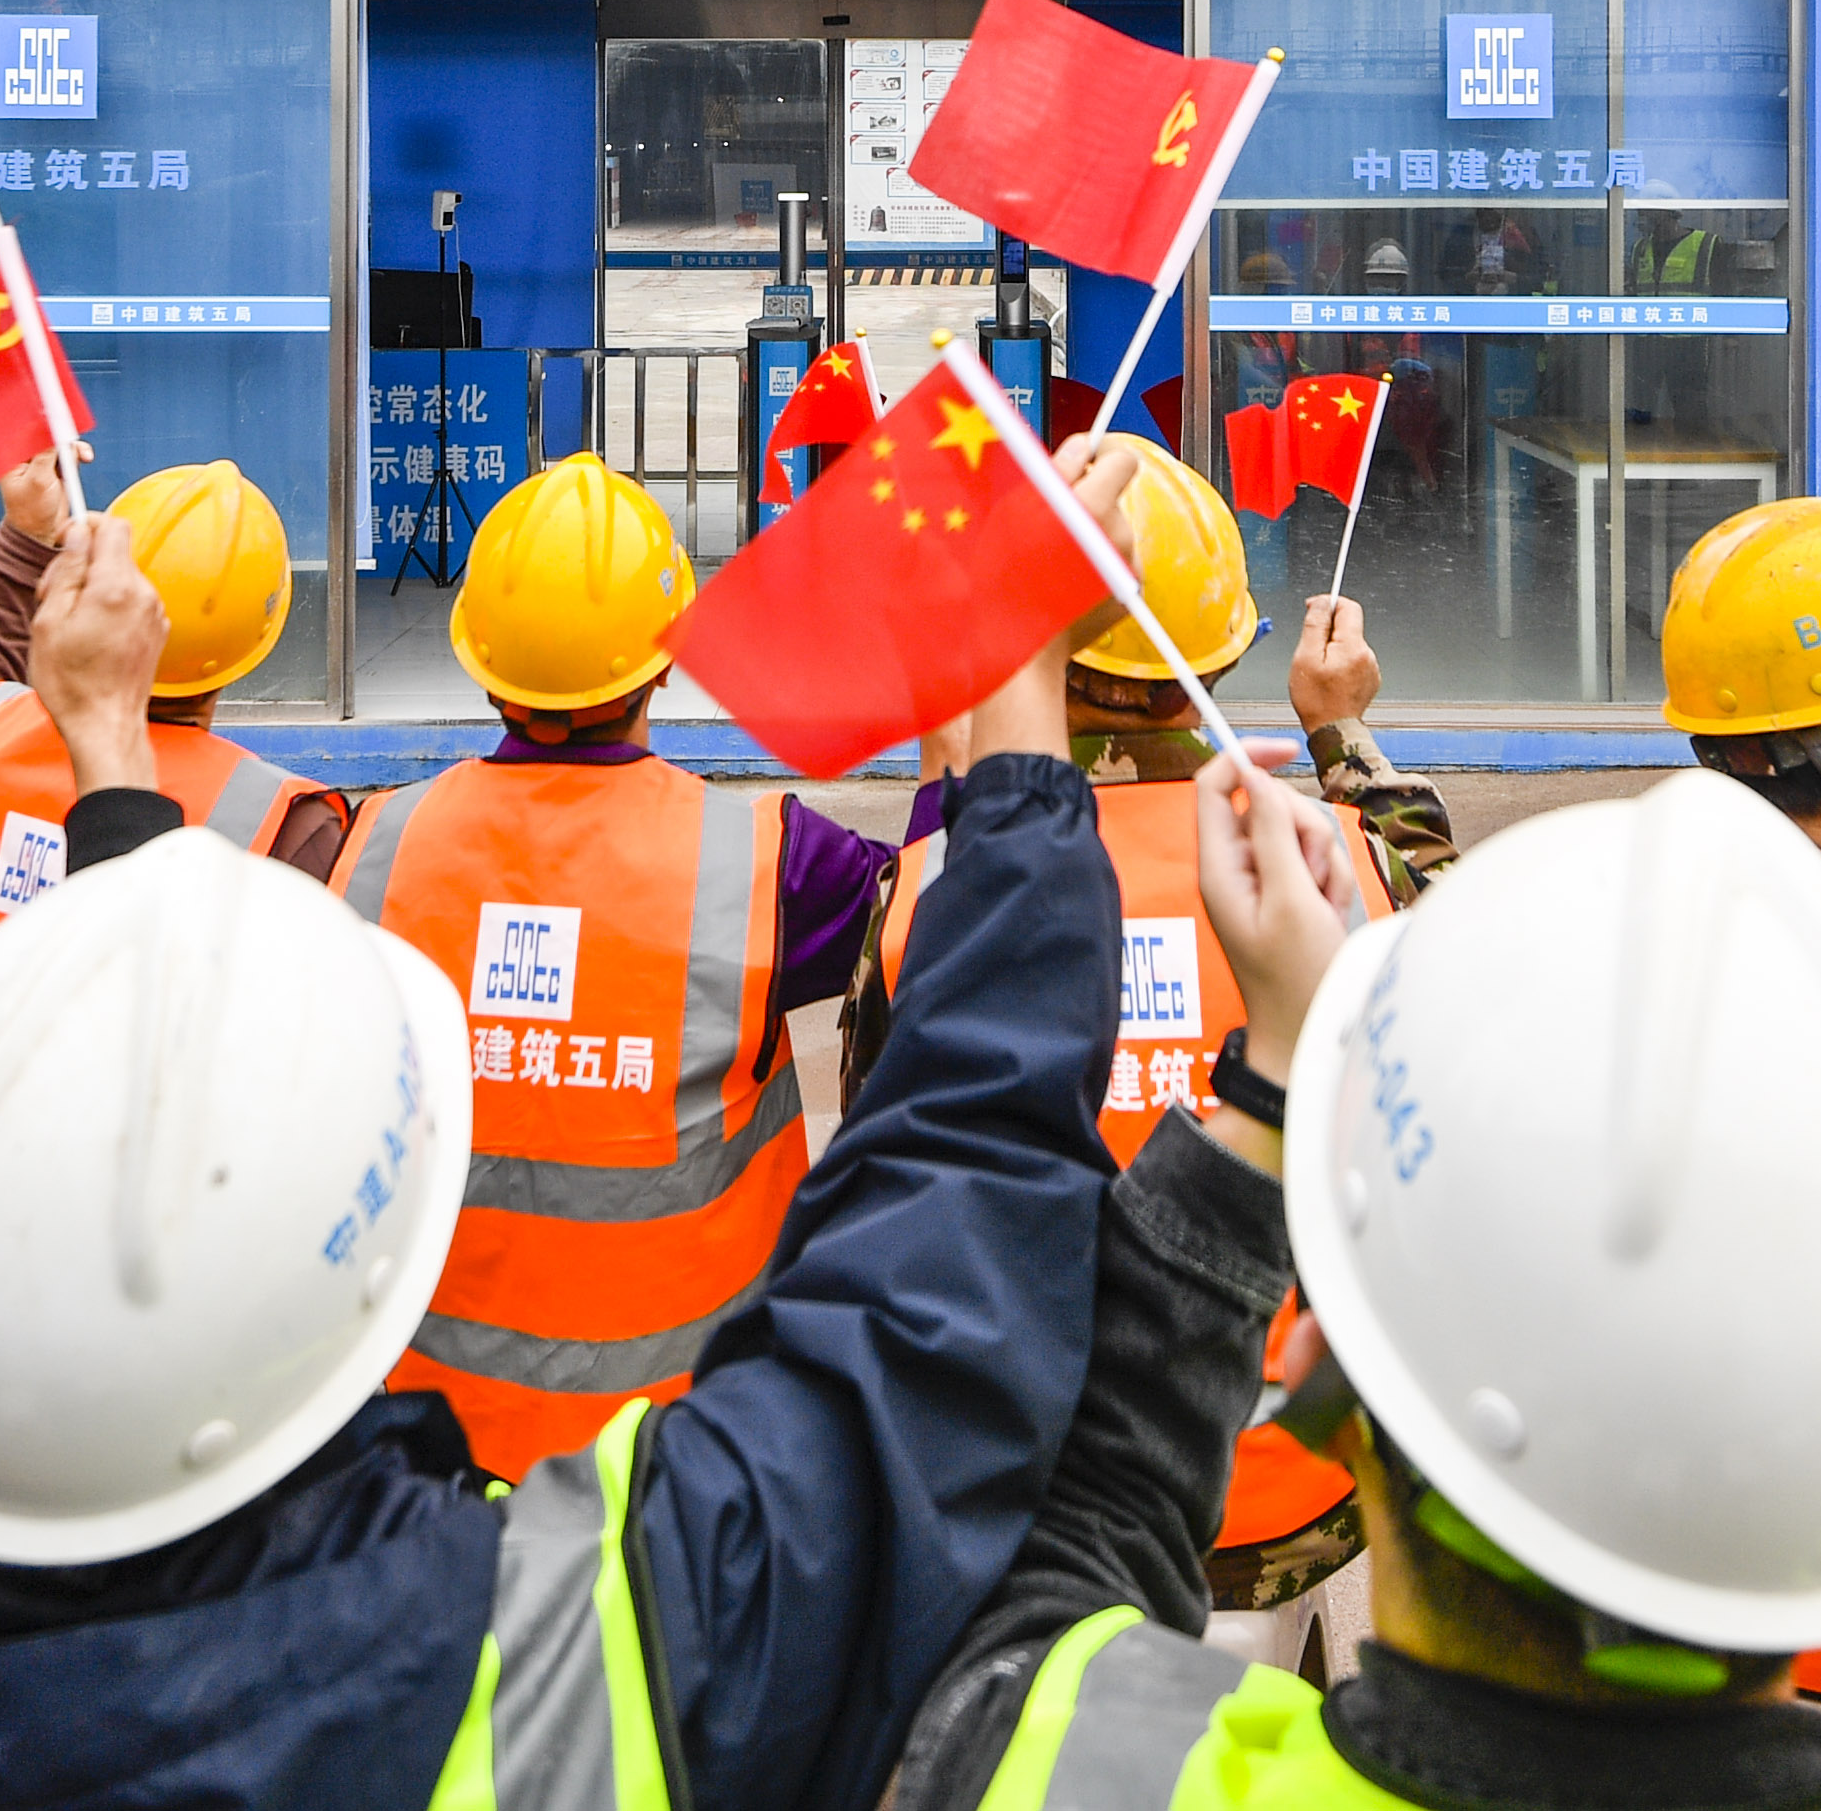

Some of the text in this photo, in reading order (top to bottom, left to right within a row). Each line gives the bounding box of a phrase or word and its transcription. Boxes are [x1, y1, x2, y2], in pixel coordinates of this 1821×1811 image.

[1352, 148, 1646, 191] 中国建筑五局
[120, 305, 253, 324] 中国建筑五局
[1320, 305, 1452, 323] 中国建筑五局
[1576, 305, 1710, 324] 中国建筑五局
[473, 1024, 655, 1094] 建筑五局
